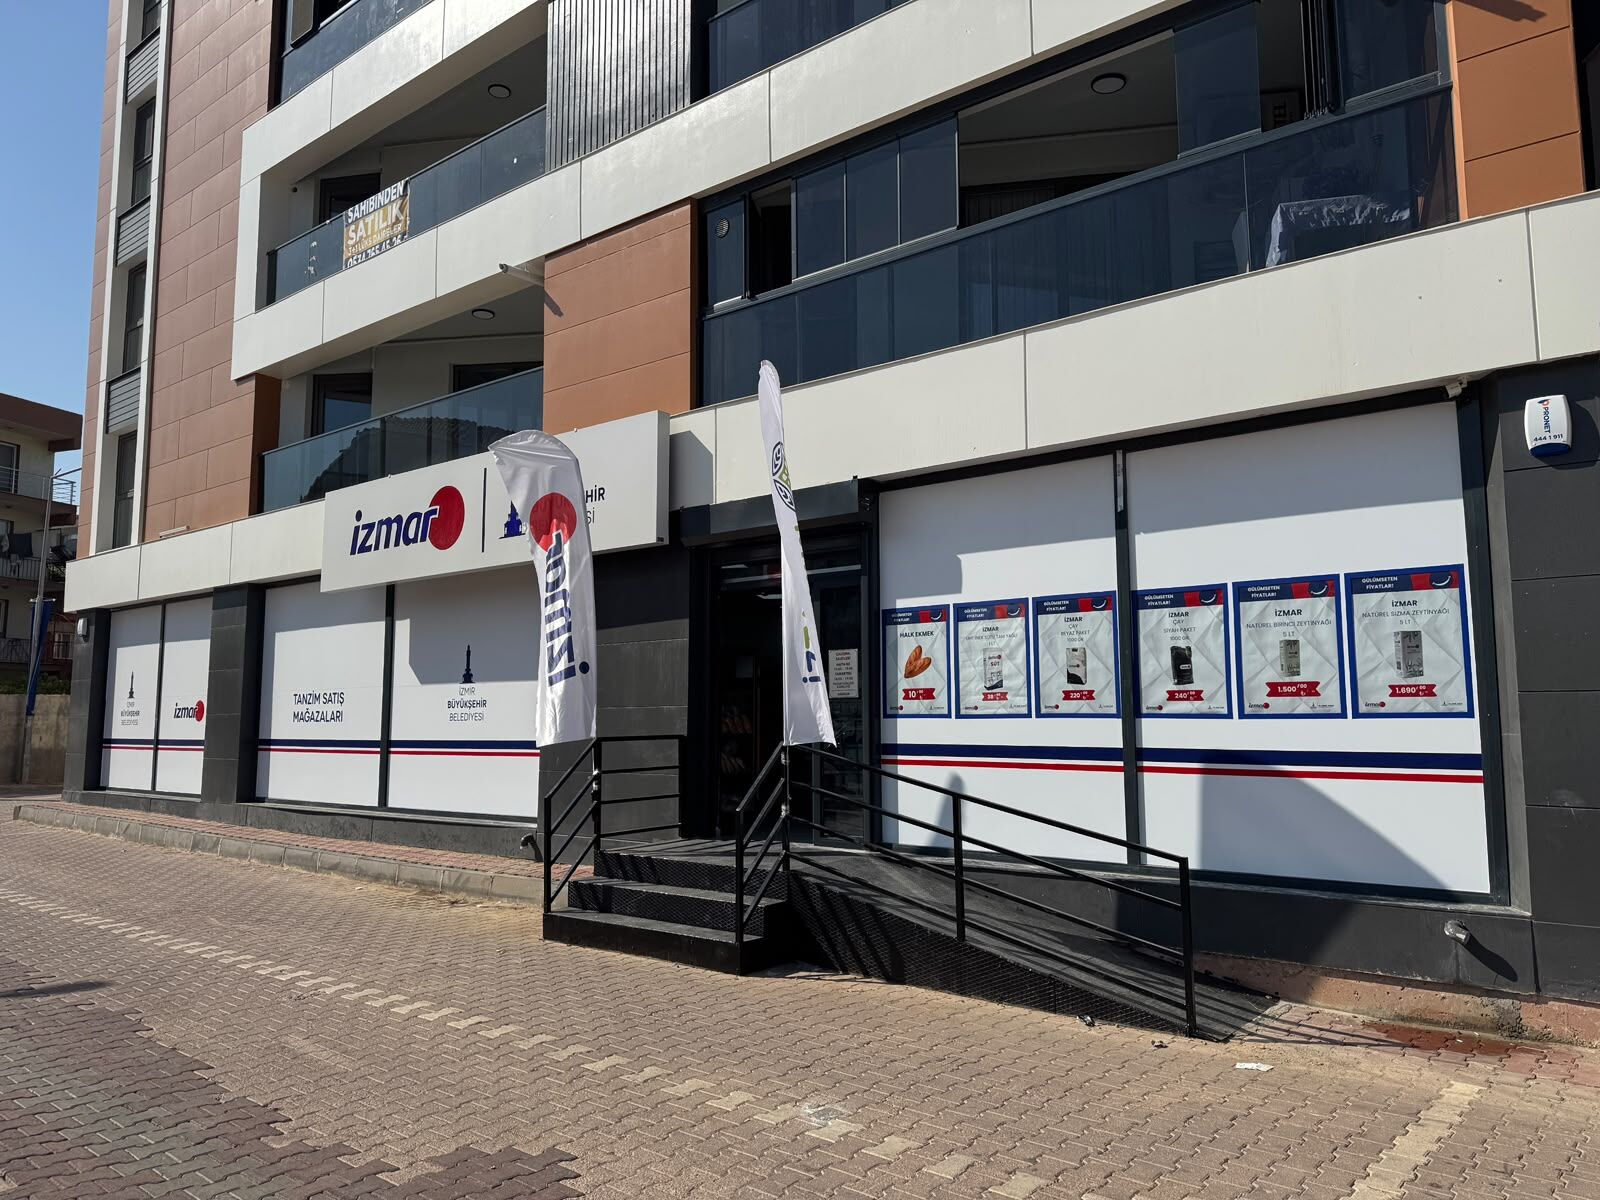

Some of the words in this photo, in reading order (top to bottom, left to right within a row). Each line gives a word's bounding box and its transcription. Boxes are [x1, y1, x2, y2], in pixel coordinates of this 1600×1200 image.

[348, 200, 404, 245] SATILIK
[1543, 406, 1551, 434] PRONET
[350, 508, 438, 555] izmar
[1275, 609, 1302, 617] İZMAR
[1362, 610, 1389, 618] NATÜREL
[459, 686, 476, 696] İZMİR
[908, 690, 917, 698] 10
[293, 690, 321, 705] TANZİM
[322, 691, 345, 707] SATIŞ
[447, 697, 487, 710] BÜYÜKŞEHİR
[173, 702, 197, 719] izmar
[293, 708, 343, 723] MAĞAZALARI
[449, 711, 485, 721] BELEDİYESİ
